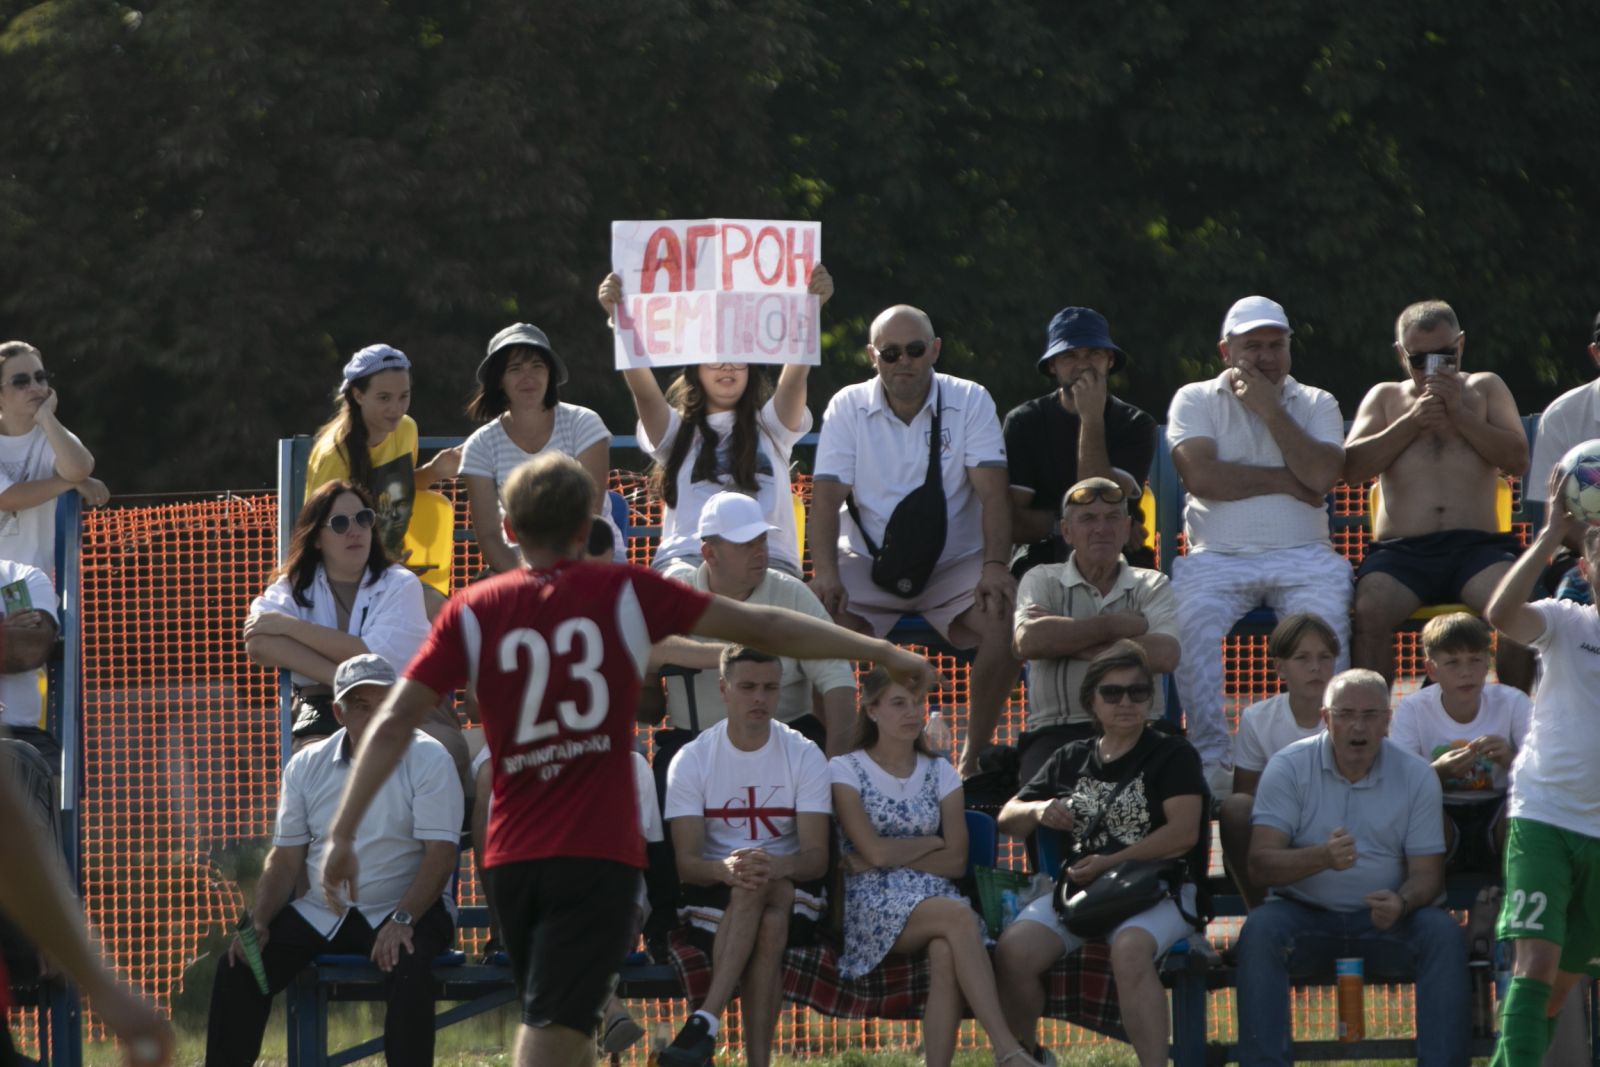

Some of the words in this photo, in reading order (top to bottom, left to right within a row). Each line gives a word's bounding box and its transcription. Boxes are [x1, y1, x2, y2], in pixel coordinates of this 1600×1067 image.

[640, 223, 815, 293] АГРОН
[498, 616, 609, 744] 23
[1510, 888, 1547, 930] 22
